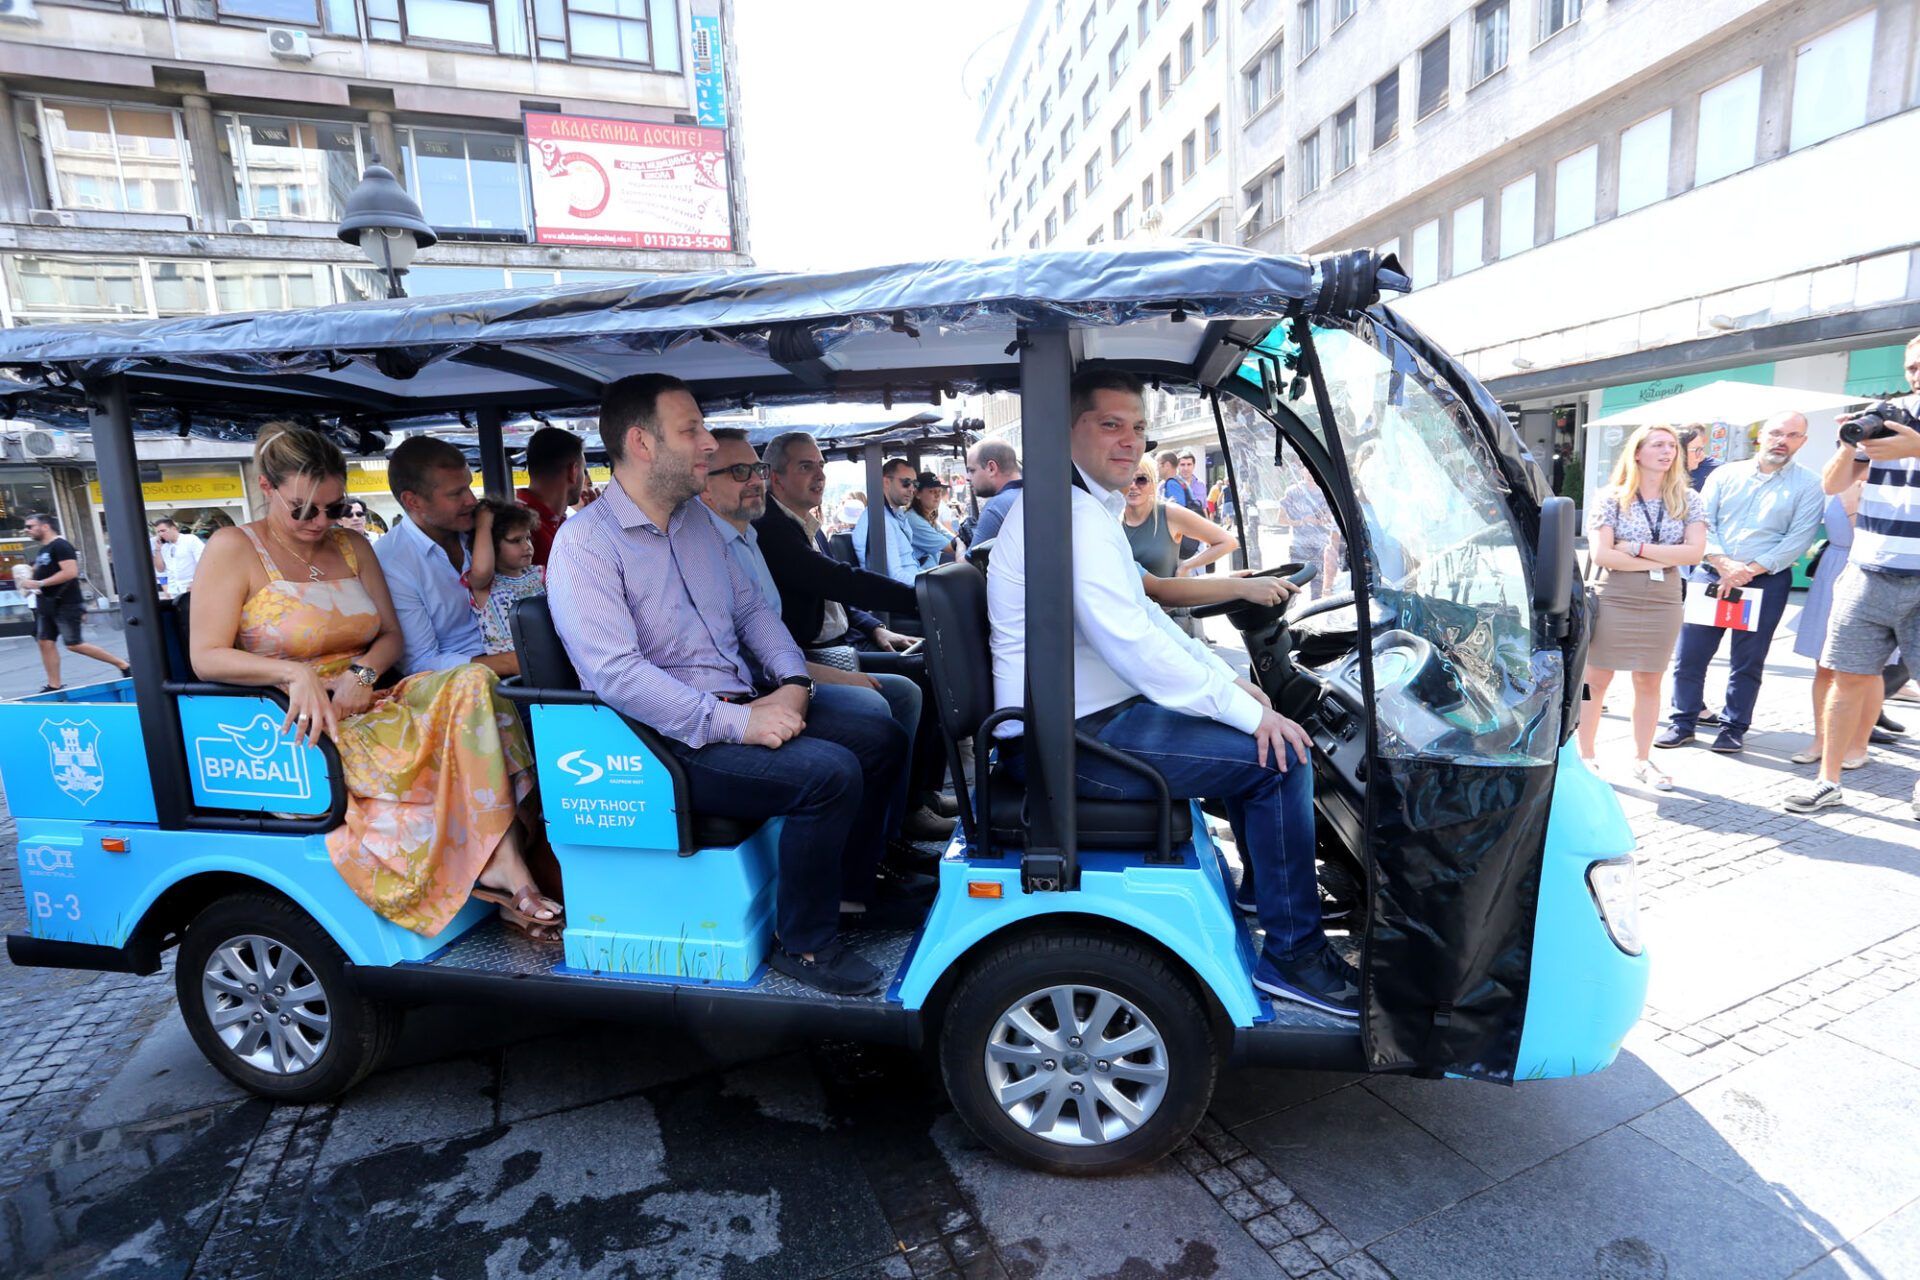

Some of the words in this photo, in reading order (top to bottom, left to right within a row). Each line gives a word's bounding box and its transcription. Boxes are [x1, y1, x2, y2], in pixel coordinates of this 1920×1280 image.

[551, 119, 639, 142] АКАДЕМИЈА
[643, 128, 702, 147] ДОСИТЕЈ
[643, 233, 728, 250] 011/323-55-00
[1640, 383, 1685, 402] Katapult
[171, 484, 202, 494] IZLOG
[607, 755, 642, 771] NIS
[561, 798, 646, 812] БУДУЋНОСТ
[575, 813, 594, 825] НА
[598, 814, 636, 828] ДЕЛУ
